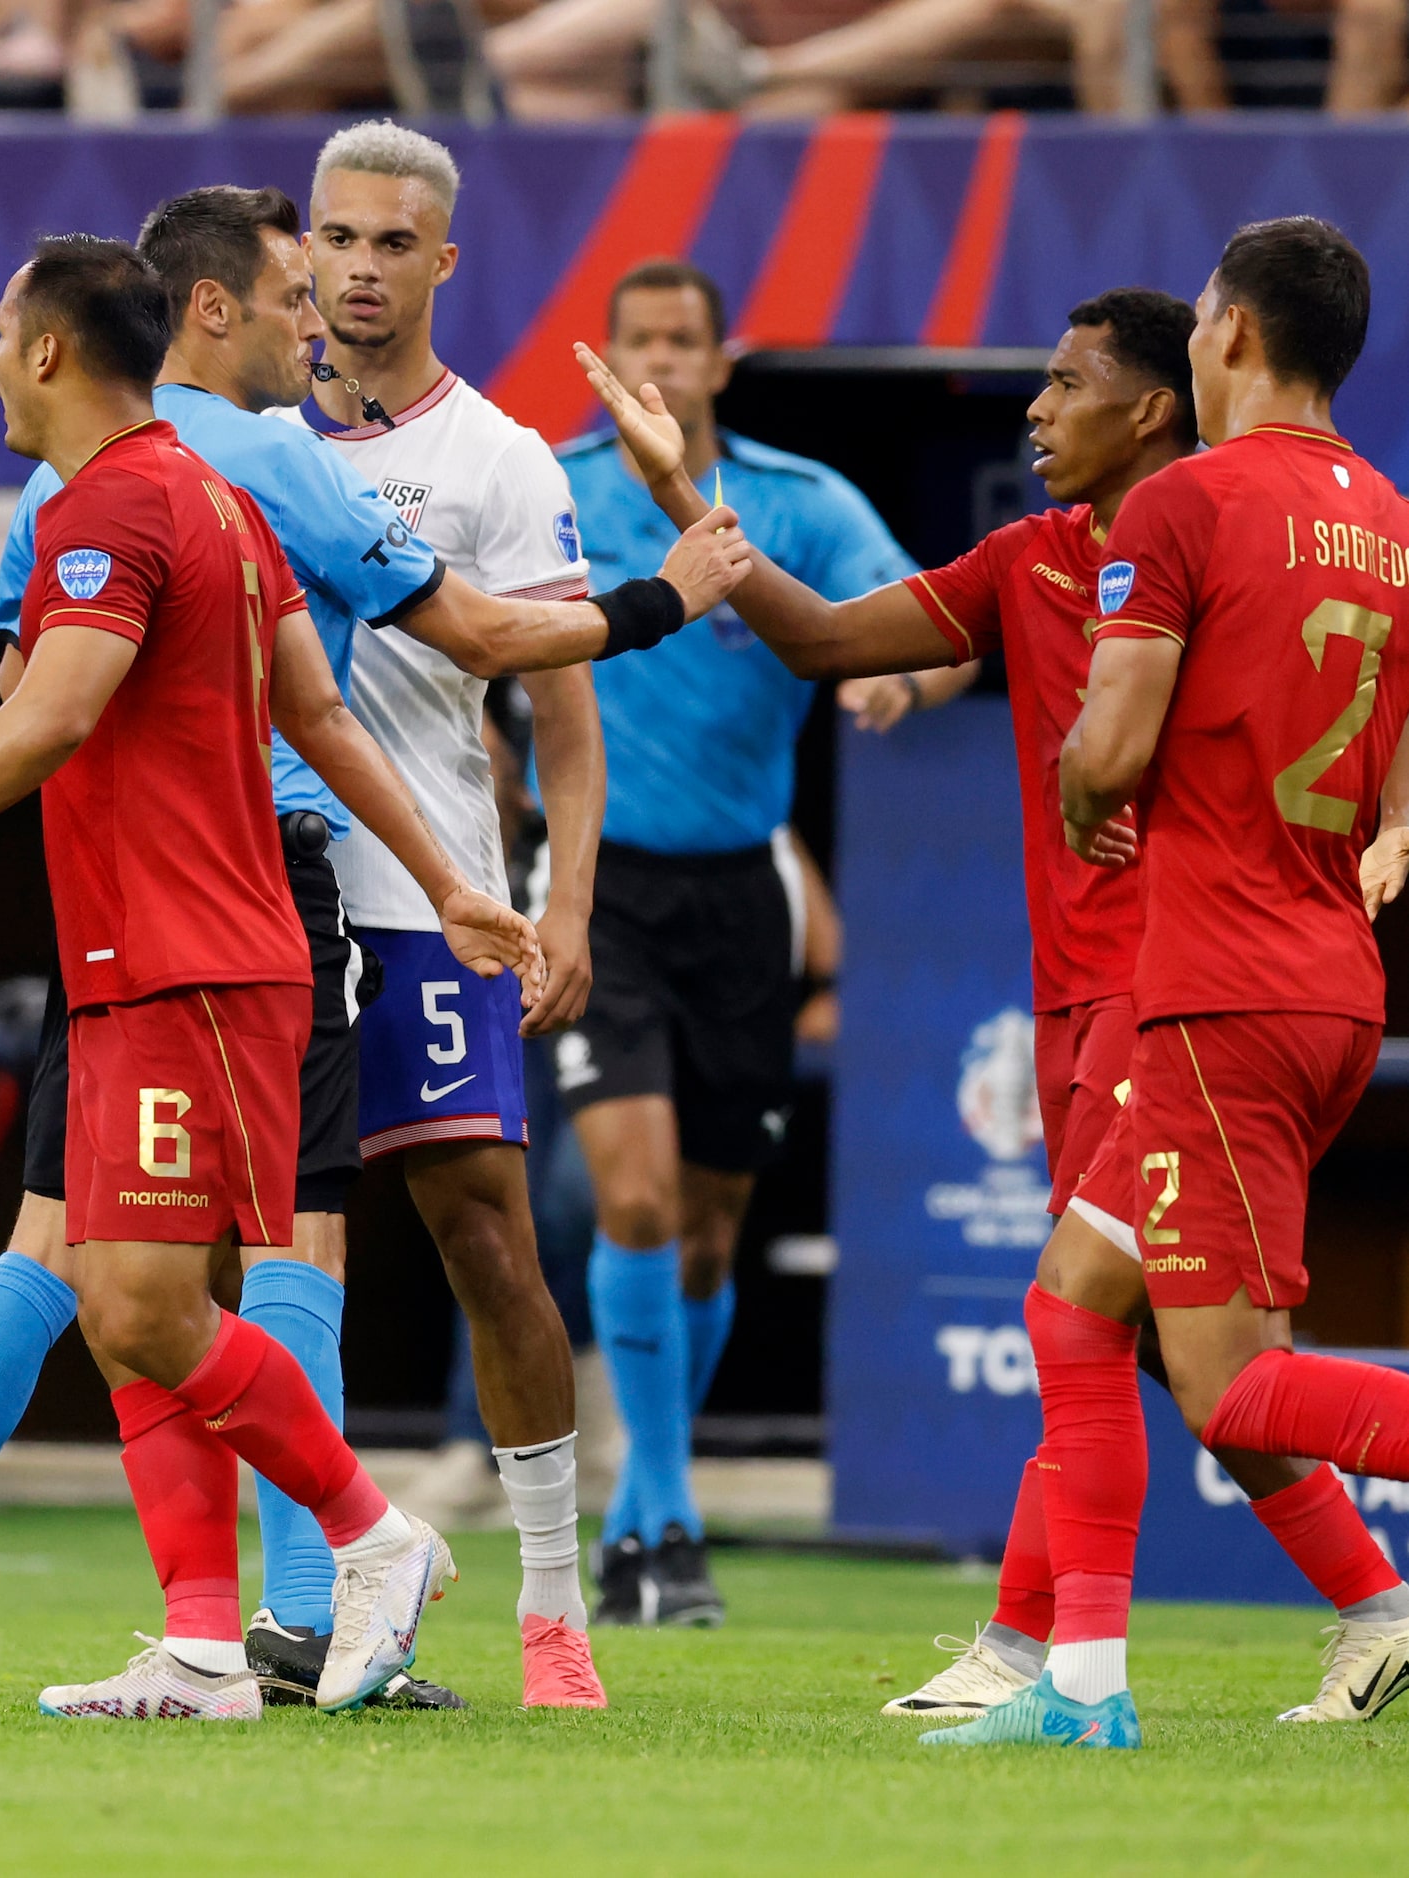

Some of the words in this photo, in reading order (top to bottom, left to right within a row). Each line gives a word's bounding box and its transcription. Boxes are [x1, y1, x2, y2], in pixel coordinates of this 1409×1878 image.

[382, 483, 426, 507] USA
[64, 563, 104, 575] VIBRA
[1286, 515, 1306, 570] J.
[1103, 576, 1130, 591] VIBRA
[1273, 598, 1393, 836] 2
[421, 980, 467, 1065] 5
[138, 1087, 192, 1178] 6
[118, 1190, 209, 1207] marathon
[1141, 1151, 1181, 1245] 2
[936, 1324, 1040, 1397] TC
